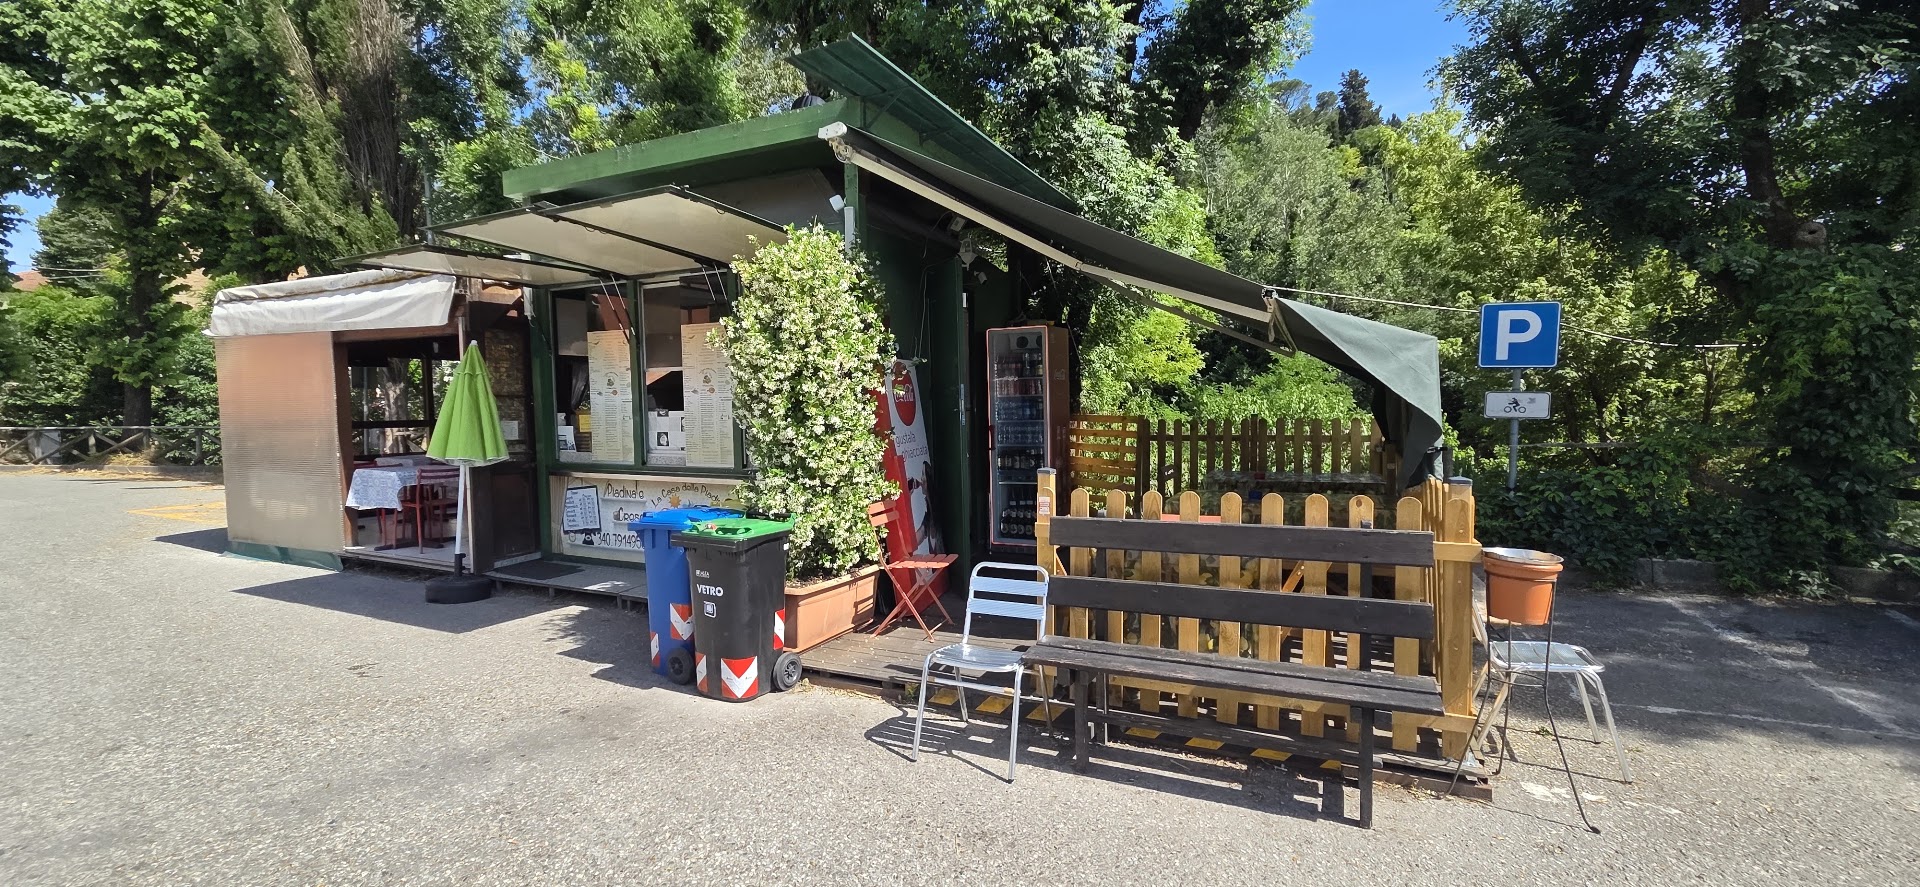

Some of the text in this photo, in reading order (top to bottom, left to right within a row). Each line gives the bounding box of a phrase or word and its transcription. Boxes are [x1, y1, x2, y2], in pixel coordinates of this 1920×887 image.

[1495, 309, 1543, 361] P
[700, 485, 721, 502] Piadi
[696, 583, 724, 597] VETRO
